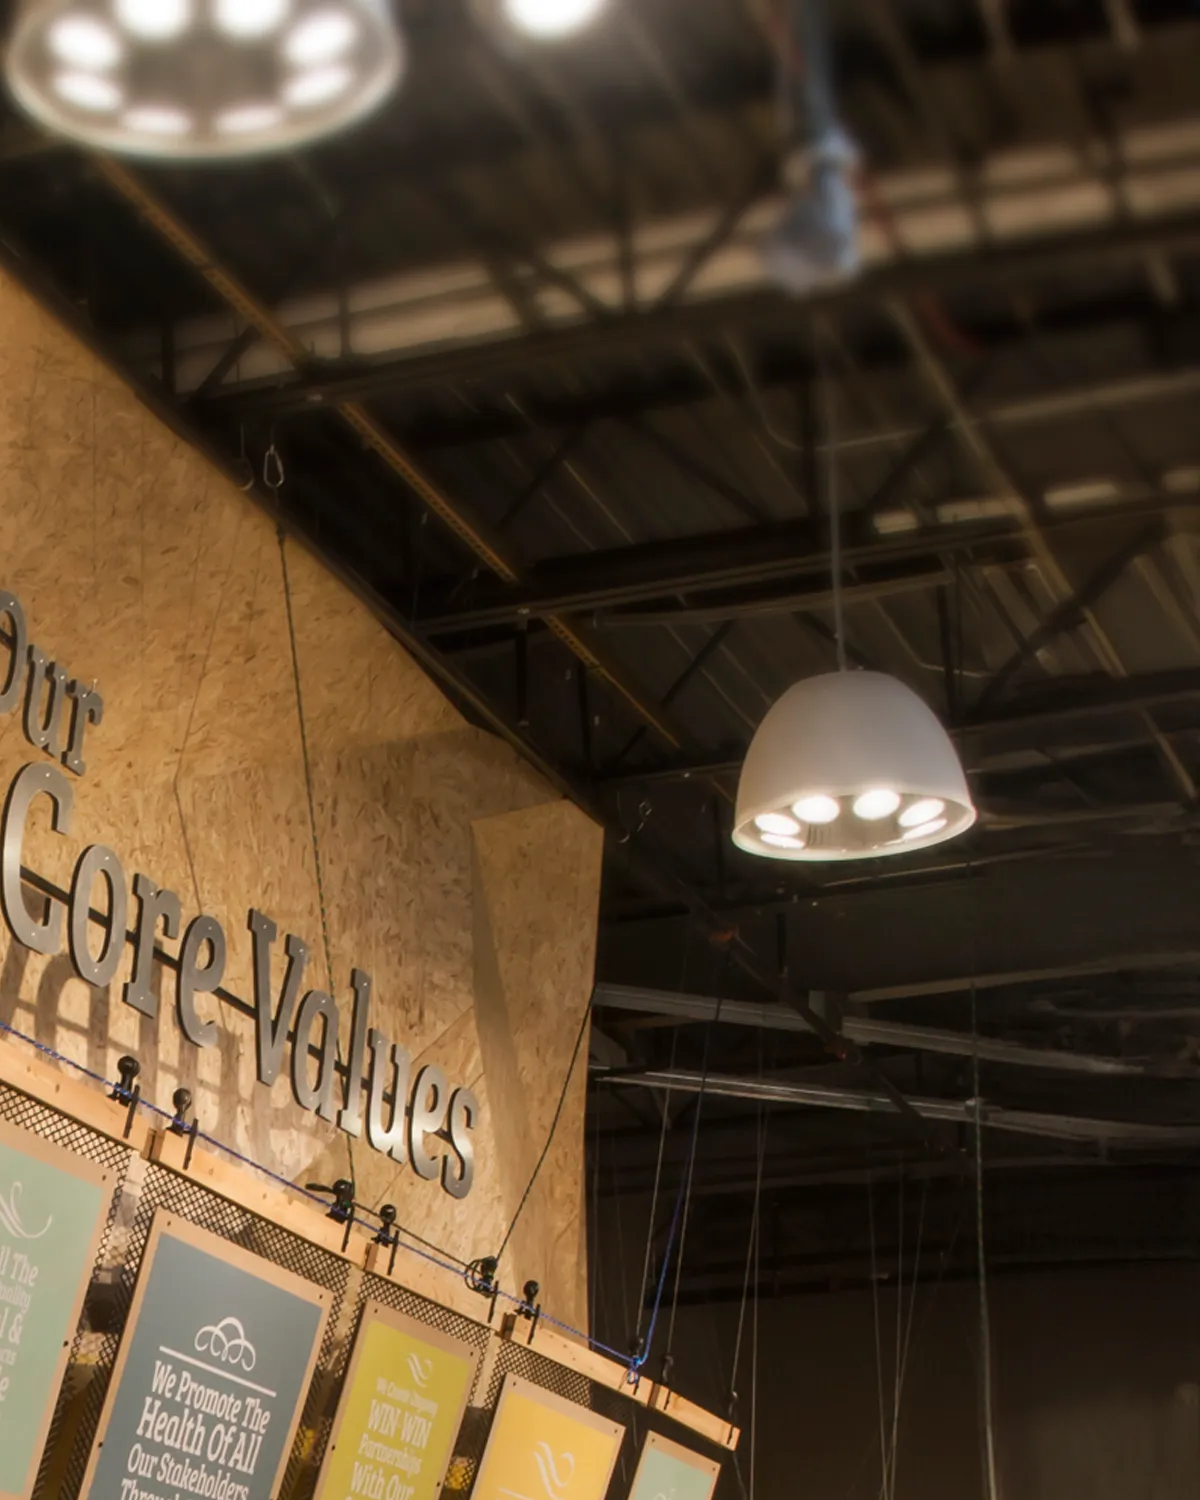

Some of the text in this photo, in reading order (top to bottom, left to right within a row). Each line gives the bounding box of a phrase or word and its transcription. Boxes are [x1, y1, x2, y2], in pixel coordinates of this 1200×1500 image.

[0, 761, 478, 1200] Core Values
[12, 1254, 38, 1286] The
[9, 1314, 23, 1344] &
[152, 1361, 270, 1433] We Promote The
[137, 1398, 262, 1474] Health Of All
[128, 1444, 157, 1477] Our
[351, 1463, 384, 1499] With
